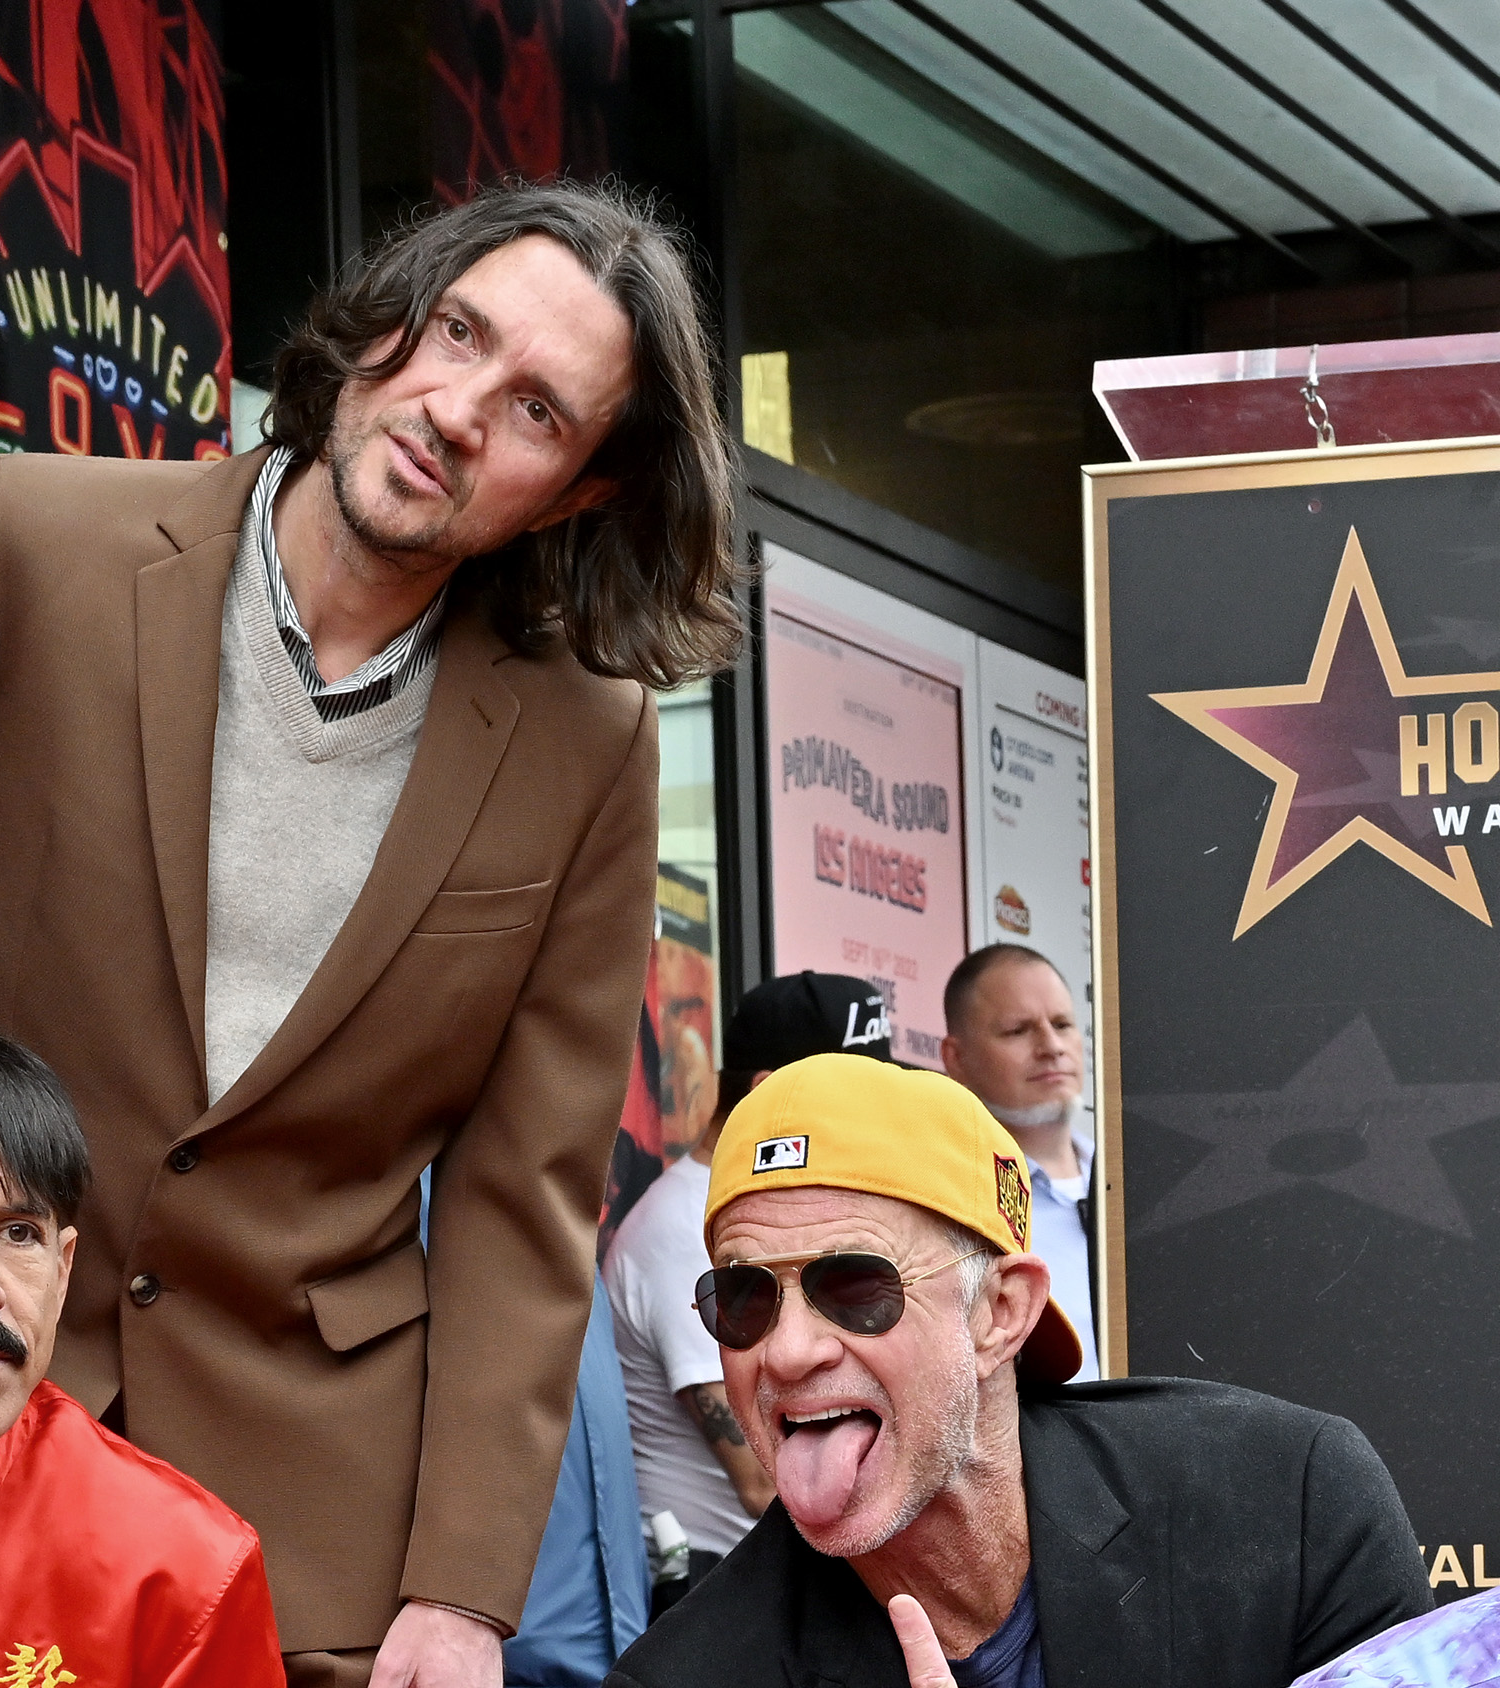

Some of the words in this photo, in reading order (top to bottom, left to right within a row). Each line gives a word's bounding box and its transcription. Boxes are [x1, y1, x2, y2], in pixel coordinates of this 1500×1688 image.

[5, 265, 219, 424] UNLIMITED
[1035, 690, 1080, 727] COMING
[782, 735, 888, 826] PRIMAVERA
[891, 781, 949, 834] SOUND
[813, 823, 846, 887] LOS
[849, 834, 928, 914] ANGELES
